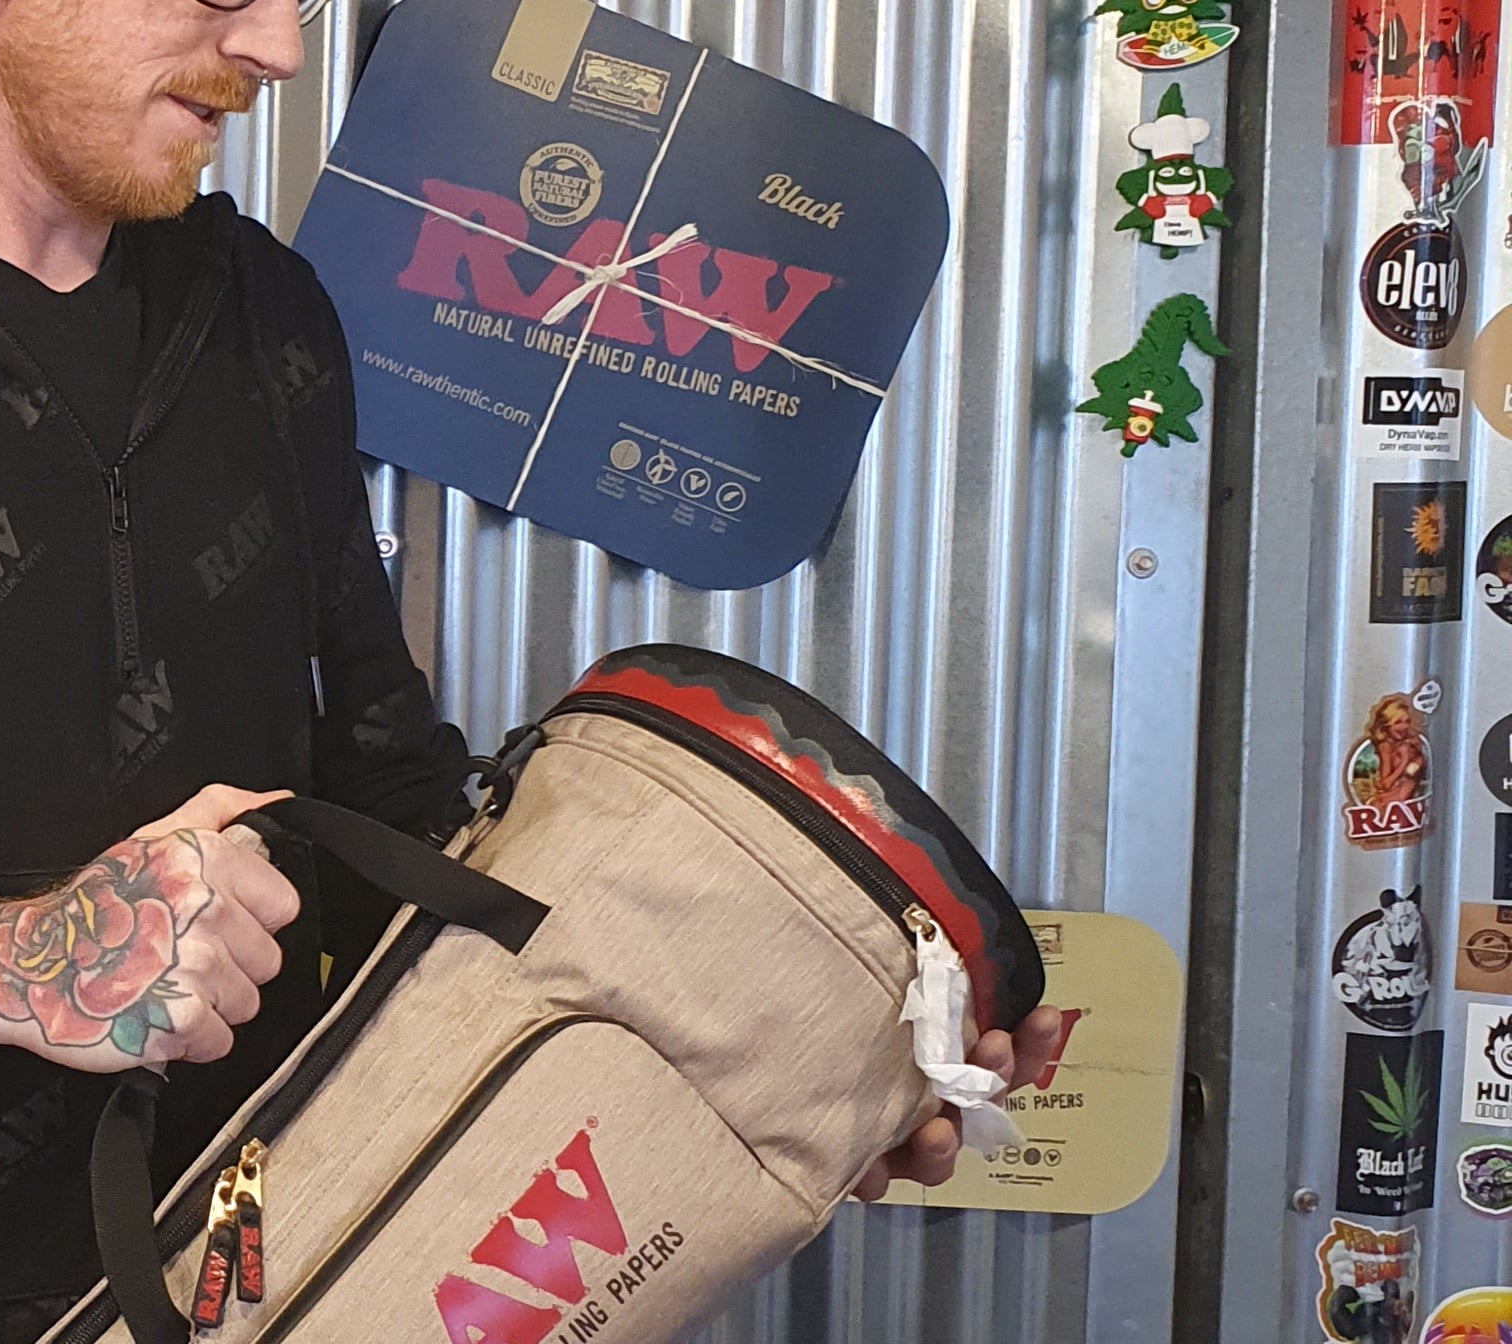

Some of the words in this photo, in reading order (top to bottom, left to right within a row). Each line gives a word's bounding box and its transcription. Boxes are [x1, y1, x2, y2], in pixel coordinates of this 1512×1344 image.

[498, 60, 557, 97] CLASSIC
[533, 170, 590, 190] PUREST
[758, 172, 845, 232] Black
[396, 177, 836, 373] RAW
[1376, 249, 1460, 318] elev8
[361, 346, 533, 428] www.rawthentic.com
[431, 301, 515, 345] NATURAL
[524, 325, 636, 374] UNREFINED
[641, 353, 720, 397] ROLLING
[729, 378, 801, 419] PAPERS
[191, 487, 278, 602] RAW
[1033, 1093, 1085, 1112] PAPERS
[1356, 1147, 1405, 1182] Black
[197, 1249, 229, 1323] RAW
[606, 1221, 686, 1306] PAPERS
